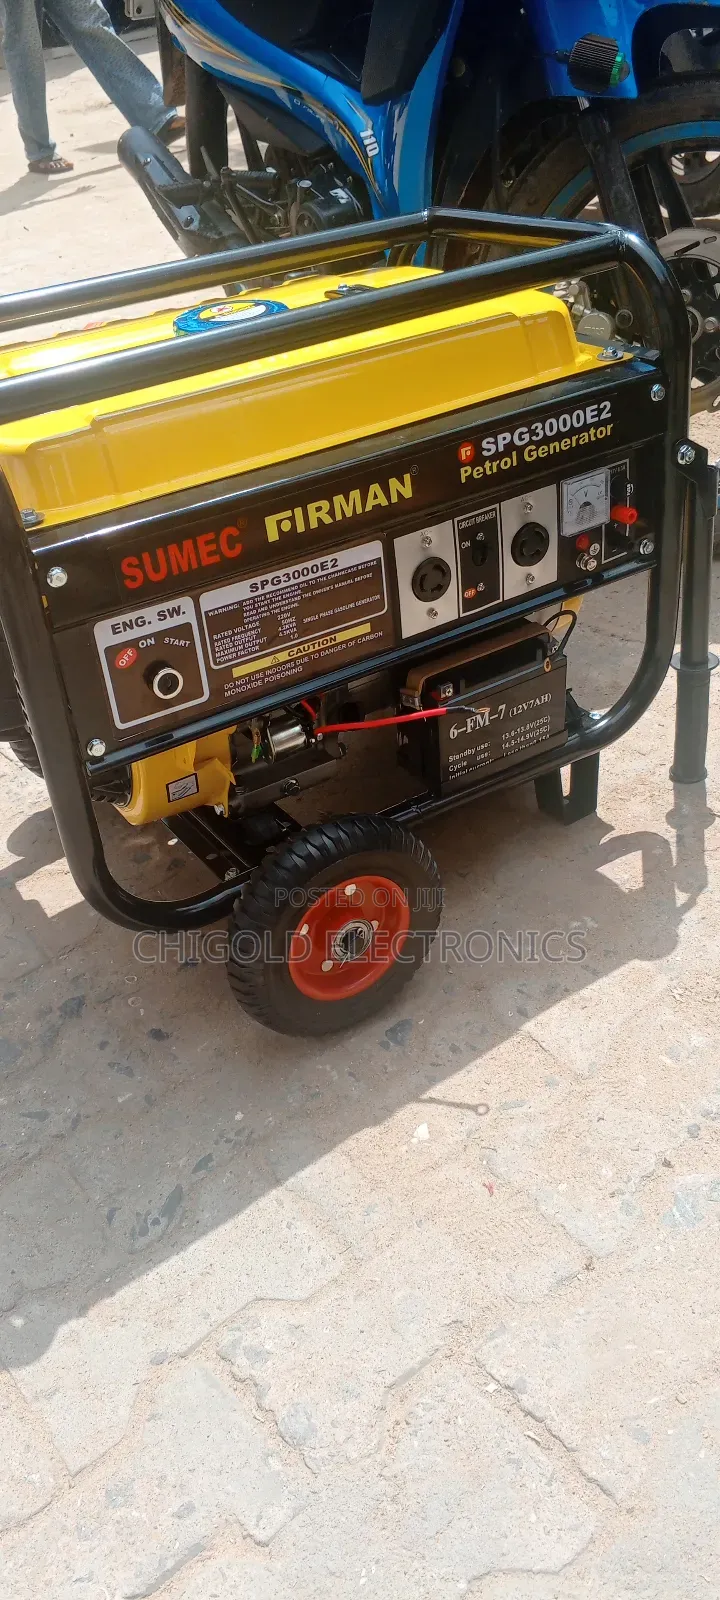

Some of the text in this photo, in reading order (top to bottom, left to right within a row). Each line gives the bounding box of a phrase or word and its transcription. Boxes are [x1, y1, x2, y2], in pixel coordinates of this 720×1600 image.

[360, 128, 379, 157] 110
[482, 400, 612, 457] SPG3000E2
[460, 423, 614, 484] Petrol Generator
[120, 473, 413, 588] SUMEC FIRMAN
[459, 510, 496, 530] CIRCUIT BREAKER
[461, 540, 471, 549] ON
[208, 603, 240, 616] WARNING:
[358, 560, 377, 570] BEFORE
[249, 558, 338, 592] SPG3000E2
[269, 596, 302, 608] UNDERSTAND
[334, 578, 354, 588] MANUAL
[355, 572, 372, 582] BEFORE
[464, 589, 476, 598] OFF
[110, 605, 186, 636] ENG. SW.
[244, 612, 270, 623] OPERATING
[302, 594, 380, 624] SINGLE PHASE GASOLINE GENERATOR
[213, 612, 291, 640] RATED VOLTAGE 220V
[214, 638, 230, 647] RATED
[232, 628, 261, 642] FREQUENCY
[138, 636, 155, 648] ON
[164, 637, 190, 648] START
[215, 642, 234, 652] RATED
[234, 634, 256, 646] OUTPUT
[216, 646, 244, 658] MAXIMUM
[244, 636, 268, 648] OUTPUT
[216, 652, 236, 663] POWER
[238, 646, 260, 656] FACTOR
[288, 636, 337, 658] CAUTION
[118, 648, 134, 666] OFF
[224, 631, 384, 690] DO NOT USE INDOORS DUE TO DANGER OF CARBON
[224, 666, 303, 698] MONOXIDE POISONING
[509, 693, 552, 718] (12V7AH)
[448, 748, 476, 762] Standby
[476, 741, 490, 750] use:
[502, 715, 550, 740] 13.6-13.8V(25C)
[448, 760, 468, 772] Cycle
[476, 751, 490, 760] use:
[502, 725, 550, 750] 14.5-14.9V(25C)
